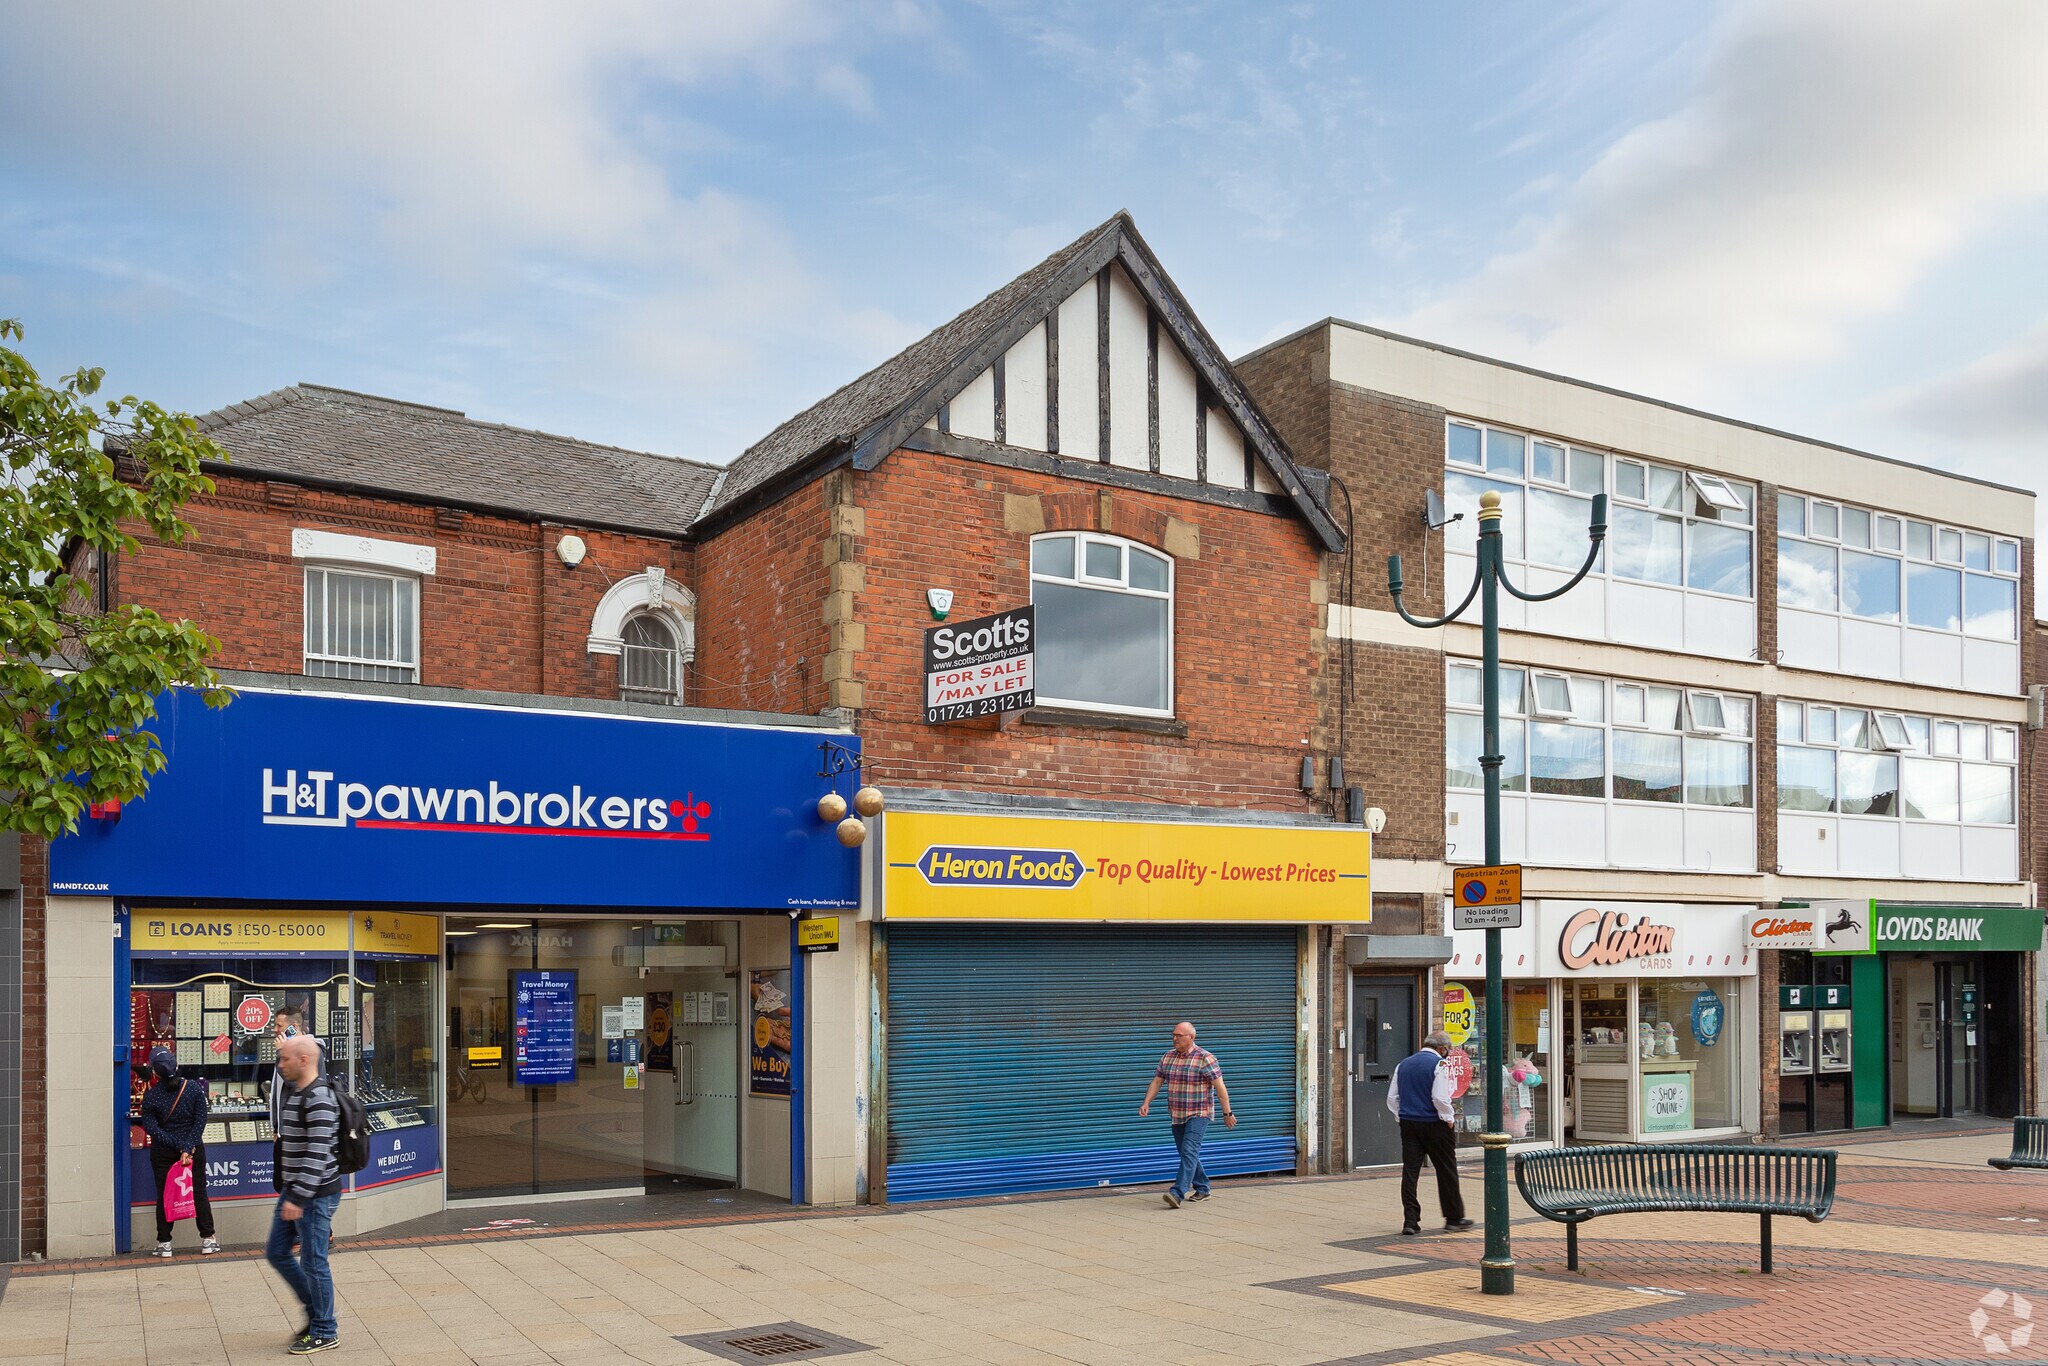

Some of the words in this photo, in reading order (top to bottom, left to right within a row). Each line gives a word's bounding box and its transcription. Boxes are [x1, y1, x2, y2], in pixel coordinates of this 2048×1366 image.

[932, 615, 1030, 659] Scotts
[933, 643, 1029, 670] www.scotts-property.co.uk
[935, 671, 973, 687] FOR
[980, 659, 1026, 679] SALE
[935, 683, 987, 703] /MAY
[994, 675, 1027, 692] LET
[929, 703, 973, 723] 01724
[980, 691, 1032, 714] 231214
[262, 768, 334, 816] H&T
[338, 780, 668, 831] pawnbrokers
[929, 852, 1003, 879] Heron
[1007, 854, 1075, 881] Foods
[1097, 858, 1131, 885] Top
[1136, 859, 1208, 886] Quality
[1220, 862, 1282, 881] Lowest
[1285, 862, 1336, 883] Prices
[1456, 870, 1498, 878] Pedestrian
[53, 882, 109, 891] HANDT.CO.UK
[813, 899, 840, 907] Pawnbroking
[171, 923, 233, 936] LOANS
[244, 924, 326, 937] £50-£5000
[803, 924, 823, 932] Western
[1751, 918, 1813, 938] Clinton
[1877, 917, 1934, 941] LOYDS
[1935, 917, 1984, 941] BANK
[380, 932, 397, 940] TRAVEL
[396, 933, 413, 941] MONEY
[809, 932, 823, 940] Union
[1559, 908, 1675, 970] Clinton
[1640, 958, 1672, 969] CARDS
[545, 981, 569, 989] Money
[245, 1007, 263, 1015] 20%
[1445, 1011, 1461, 1024] FOR
[1461, 1008, 1471, 1030] 3
[752, 1056, 767, 1072] We
[770, 1057, 789, 1077] Buy
[1447, 1056, 1462, 1066] GIFT
[1445, 1066, 1464, 1076] BAGS
[1659, 1087, 1677, 1101] SHOP
[1657, 1102, 1678, 1115] ONLINE
[1648, 1123, 1689, 1131] clintonsretail.co.uk
[378, 1157, 387, 1167] WE
[388, 1155, 400, 1166] BUY
[400, 1151, 416, 1163] GOLD
[205, 1160, 240, 1177] ANS
[206, 1179, 239, 1188] 0-£5000
